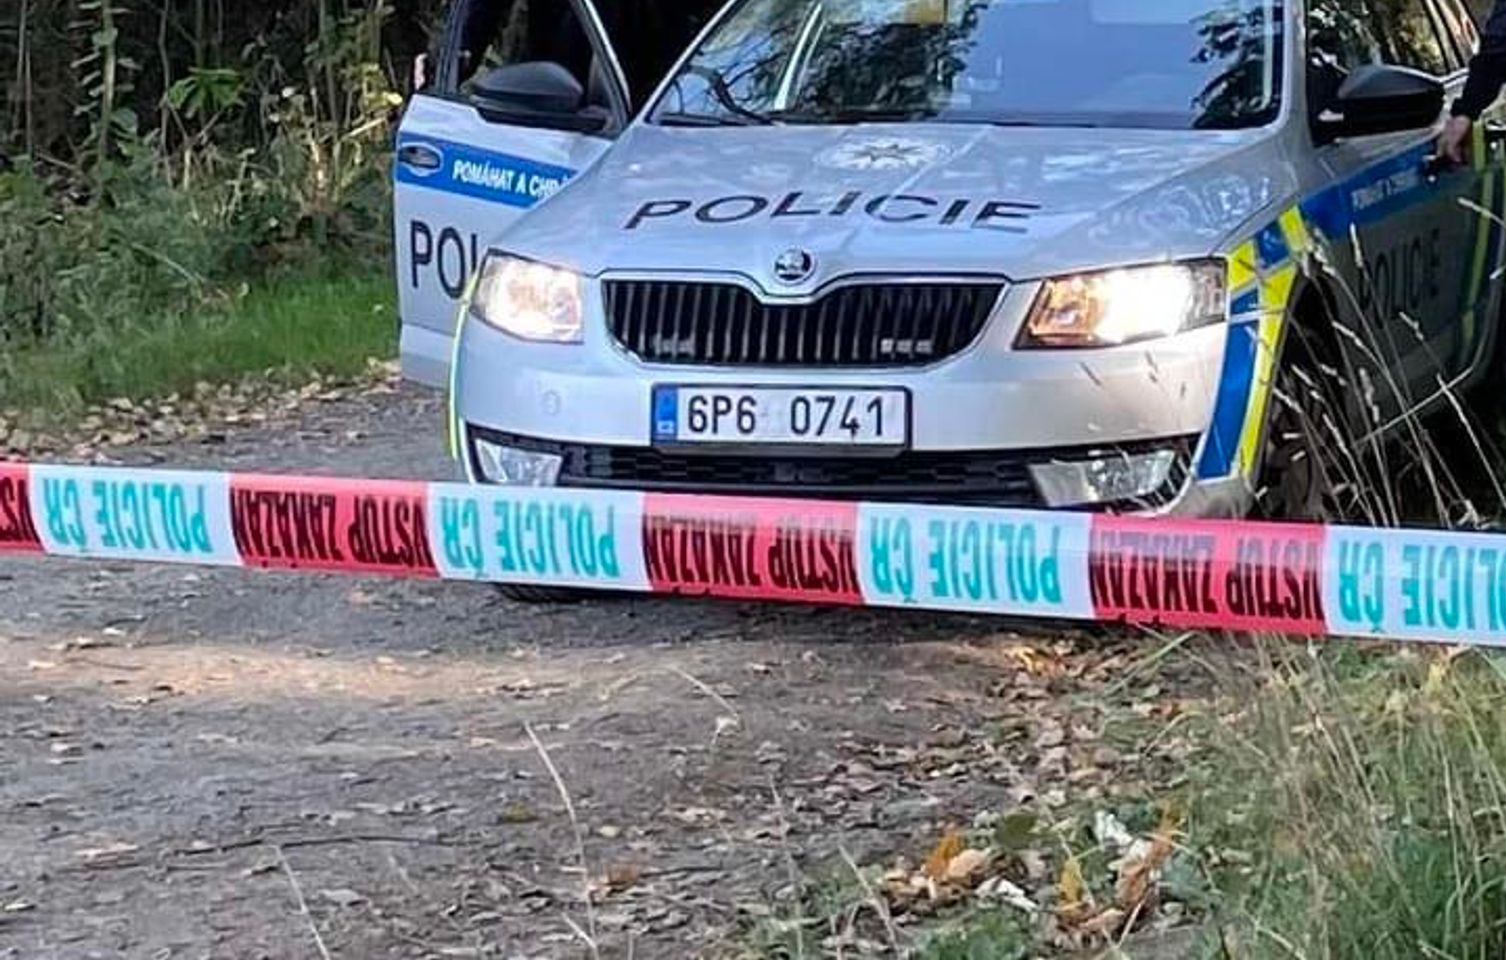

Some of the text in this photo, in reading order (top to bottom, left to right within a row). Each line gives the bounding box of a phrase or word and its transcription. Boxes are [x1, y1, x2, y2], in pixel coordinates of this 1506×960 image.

[453, 158, 515, 192] POMÁHAT
[515, 172, 527, 194] A
[623, 191, 1043, 234] POLICIE
[687, 395, 883, 437] 6P6 0741
[92, 481, 214, 555] POLICIE
[348, 496, 436, 569] VSTUP
[441, 496, 620, 579] POLICIE ČR
[767, 519, 861, 596] VSTUP
[870, 517, 1063, 605] POLICIE ČR
[1225, 540, 1326, 623] VSTUP
[1340, 541, 1390, 634] ČR
